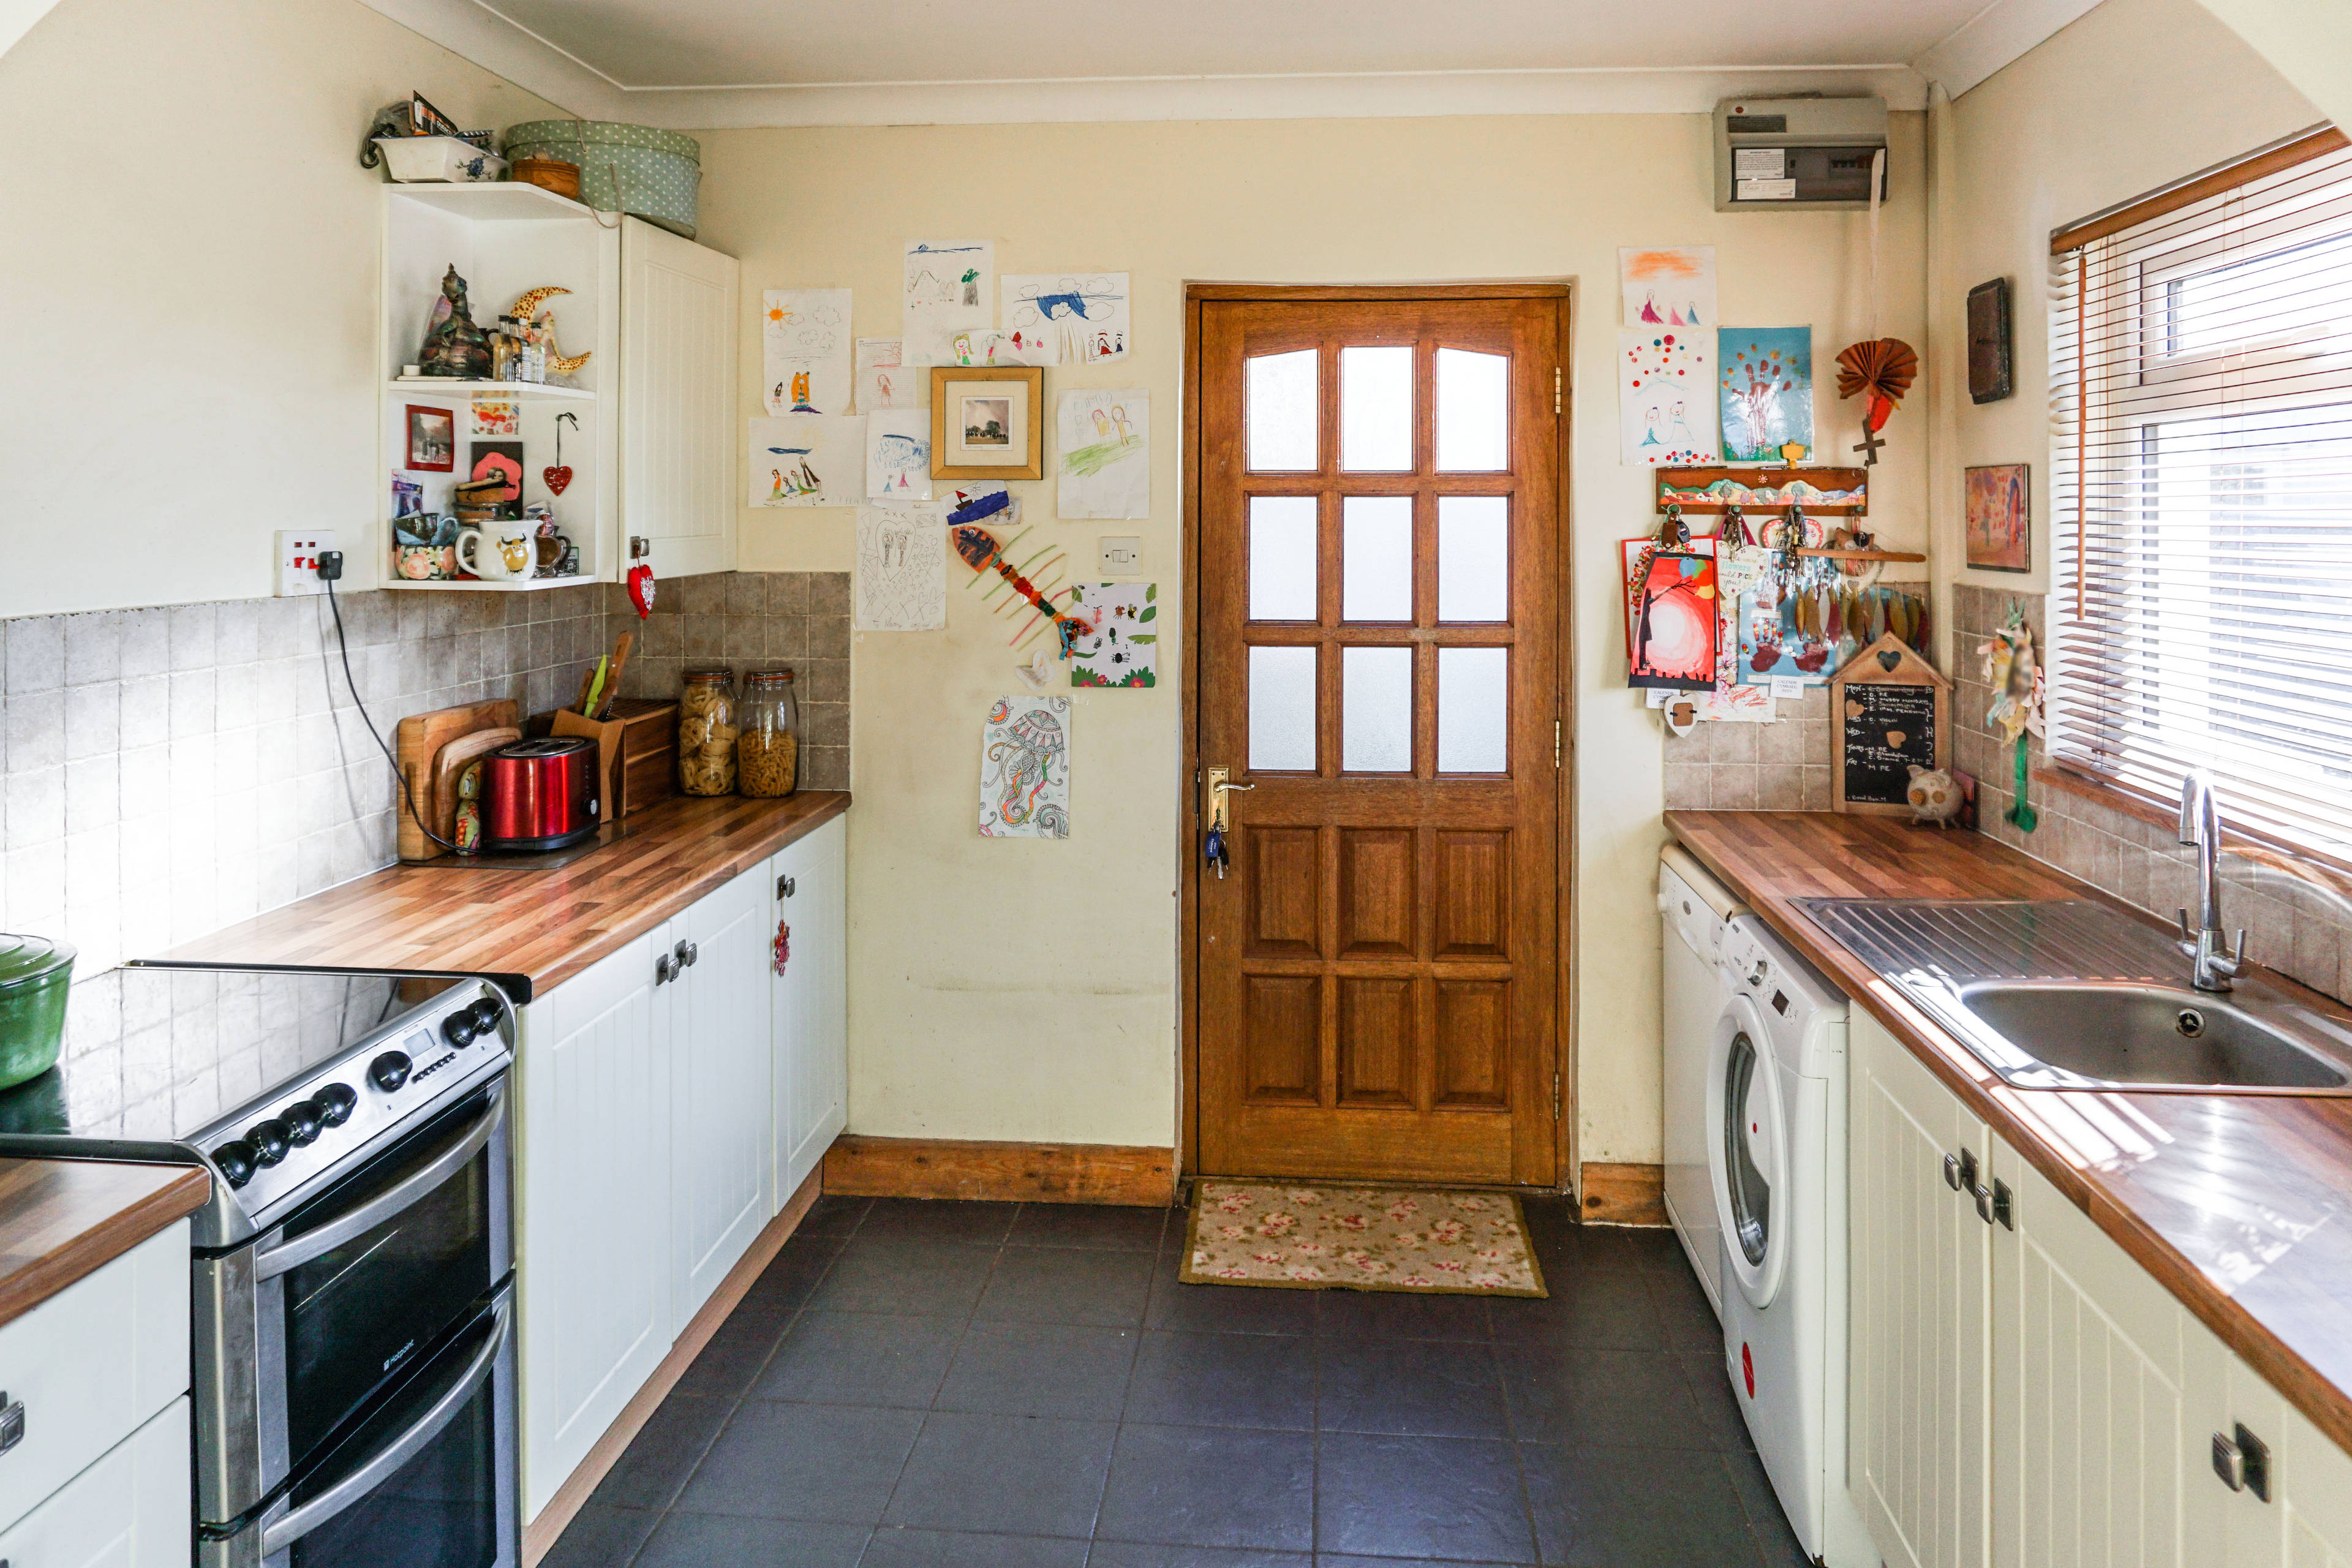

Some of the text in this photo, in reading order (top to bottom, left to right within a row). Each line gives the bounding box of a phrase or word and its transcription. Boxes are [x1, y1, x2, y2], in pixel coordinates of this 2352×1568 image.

[1722, 561, 1751, 571] flowers
[1723, 578, 1741, 590] you!
[390, 1339, 415, 1365] Hotpoint
